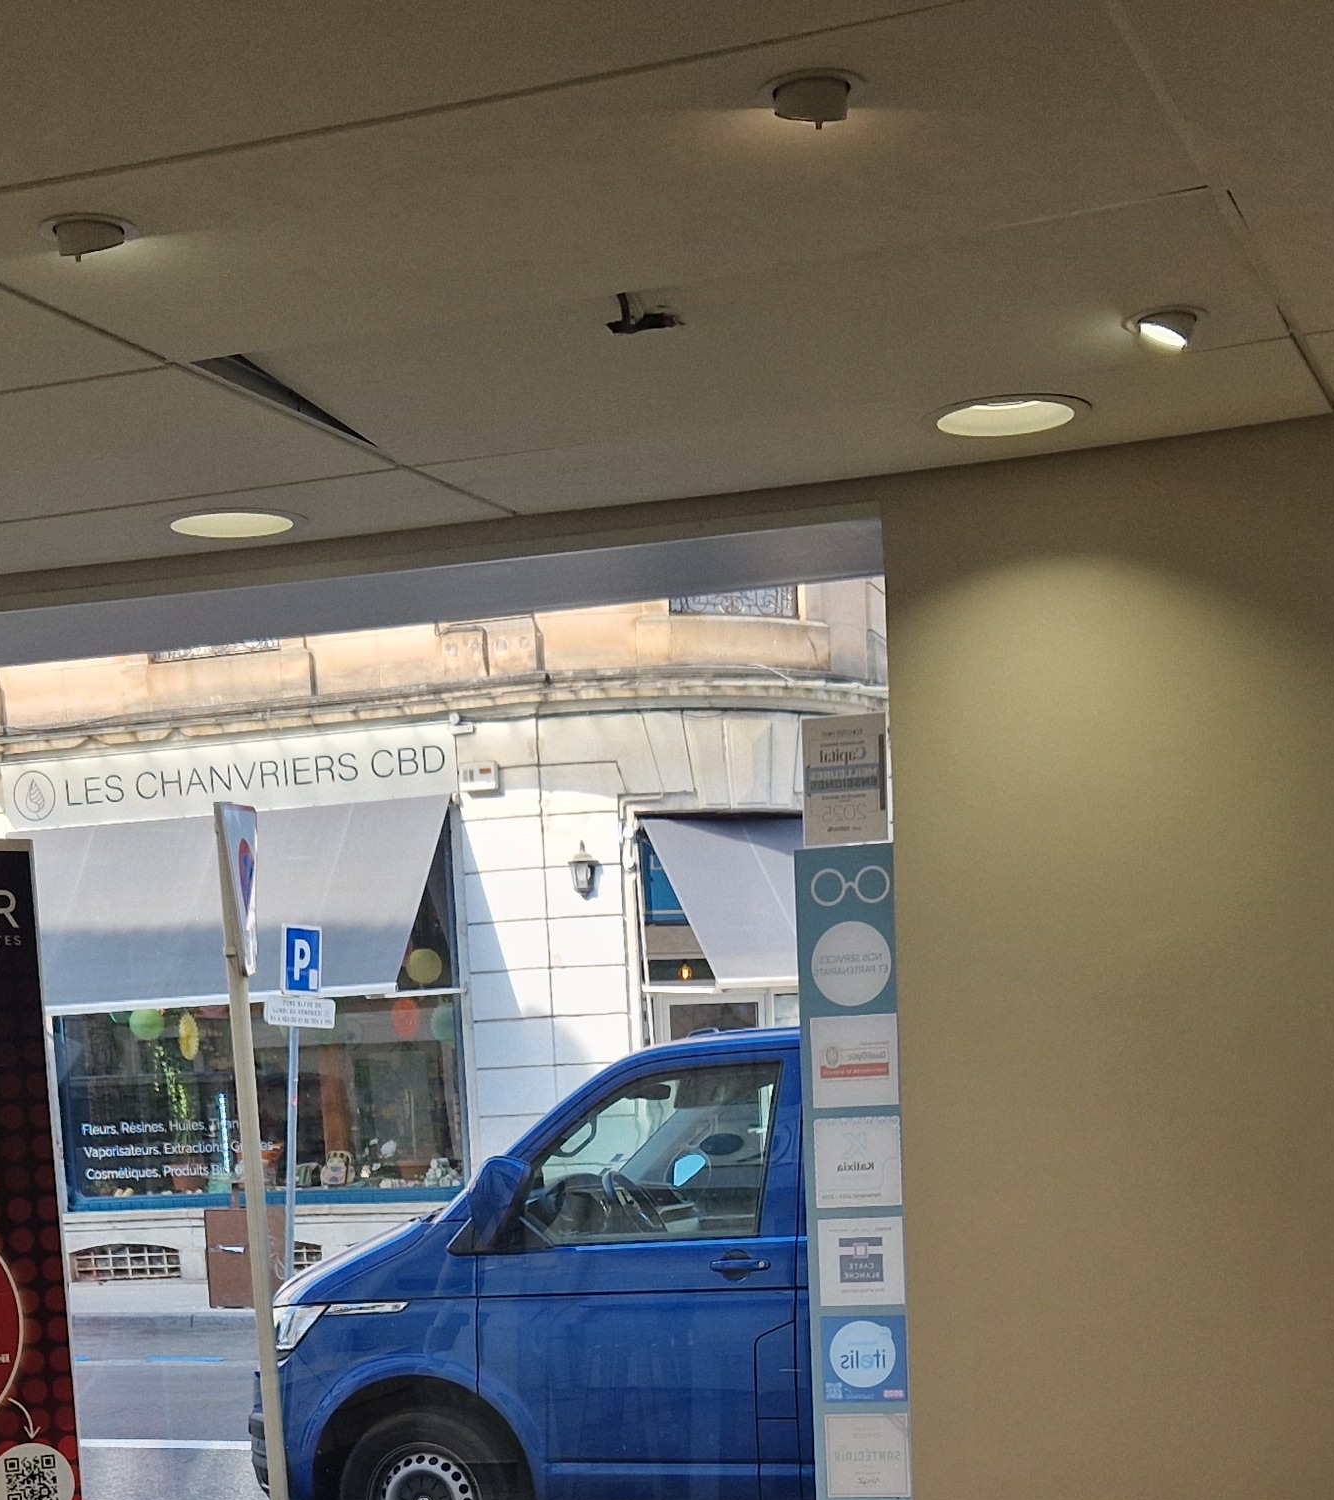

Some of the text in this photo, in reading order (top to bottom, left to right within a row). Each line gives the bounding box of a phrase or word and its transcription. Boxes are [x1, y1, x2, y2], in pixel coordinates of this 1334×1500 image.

[65, 744, 446, 807] LES CHANVRIERS CBD
[294, 938, 311, 981] P
[81, 1122, 119, 1136] Fleurs,
[121, 1120, 167, 1134] Résines,
[169, 1118, 207, 1132] Huiles,
[83, 1144, 162, 1161] Vaporisateurs,
[85, 1167, 162, 1182] Cosmétiques,
[162, 1165, 210, 1179] Produits
